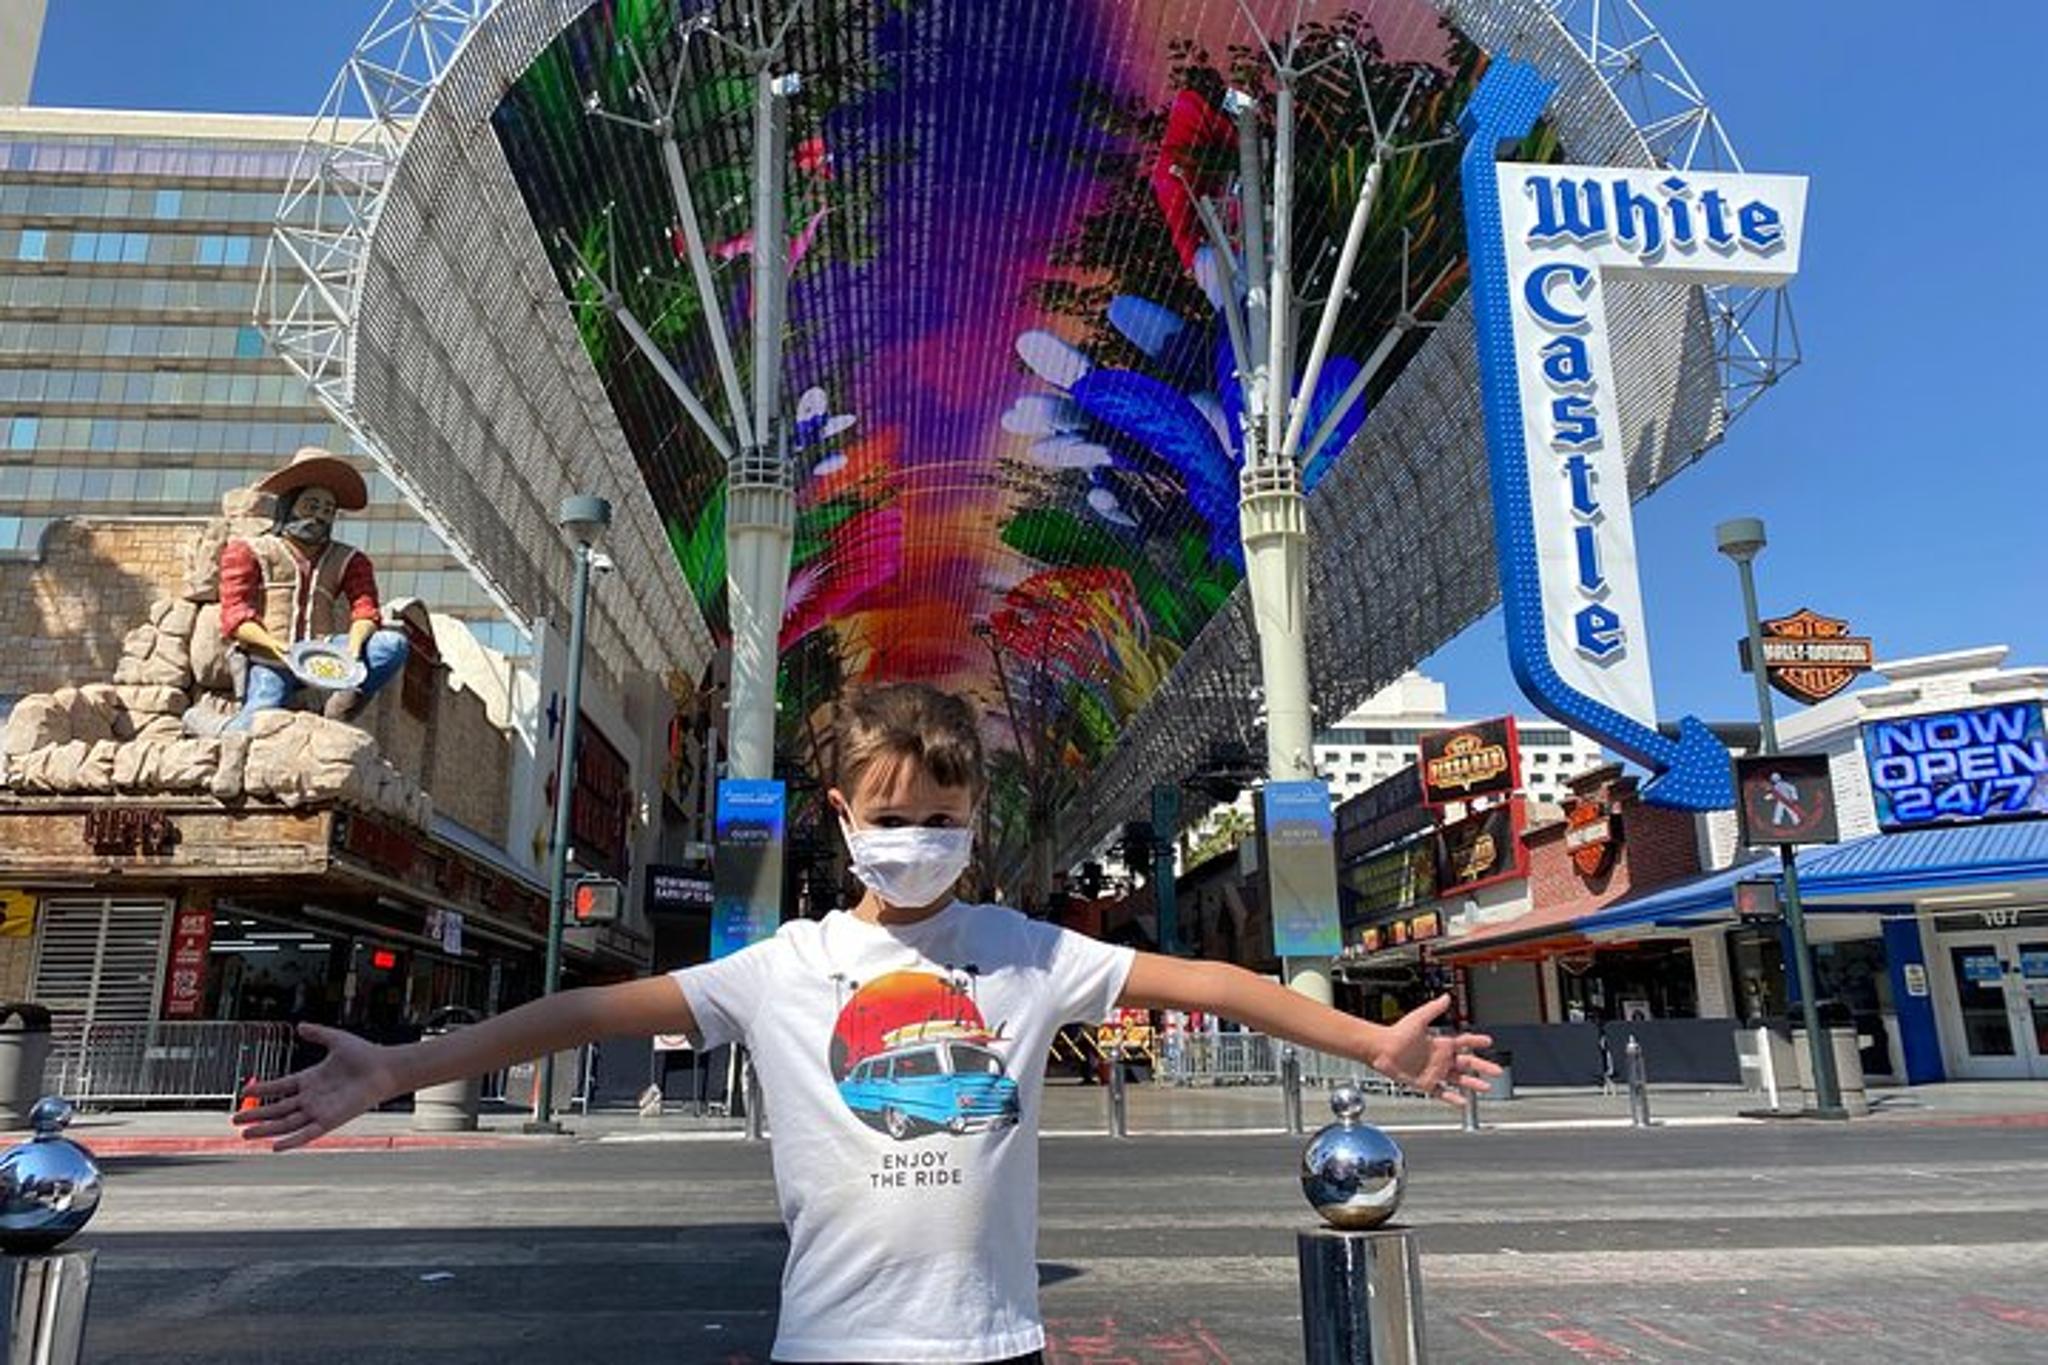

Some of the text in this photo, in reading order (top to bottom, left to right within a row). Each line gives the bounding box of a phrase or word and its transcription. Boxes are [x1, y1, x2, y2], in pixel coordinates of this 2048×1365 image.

[1524, 175, 1783, 256] White
[1523, 262, 1622, 658] Castle
[1878, 707, 2026, 755] NOW
[1873, 739, 2047, 790] OPEN
[1893, 774, 2036, 821] 24/7
[870, 1168, 963, 1189] THE RIDE
[883, 1151, 948, 1169] ENJOY
